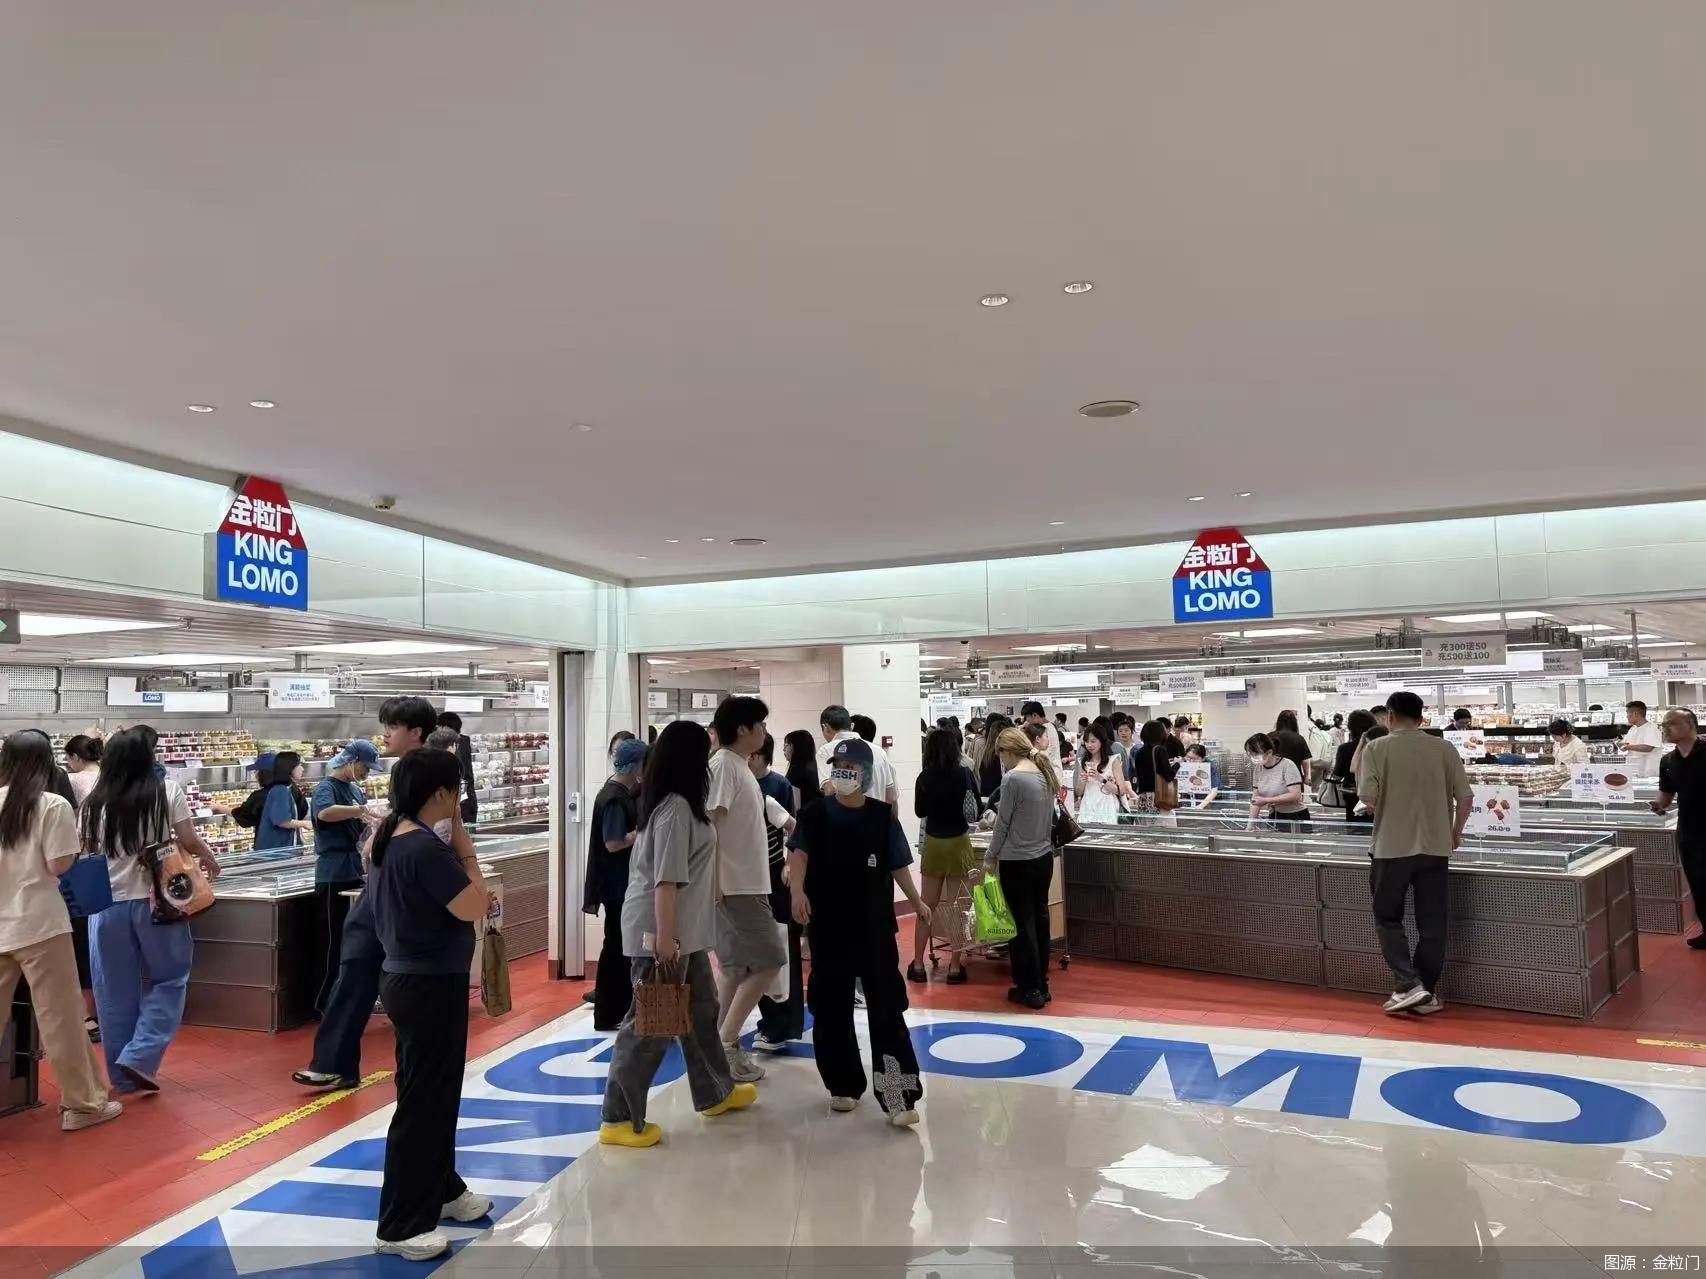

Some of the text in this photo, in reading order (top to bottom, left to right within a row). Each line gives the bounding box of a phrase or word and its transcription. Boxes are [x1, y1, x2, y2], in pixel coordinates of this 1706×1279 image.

[228, 494, 297, 536] 金粒门
[234, 530, 293, 565] KING
[1183, 542, 1256, 568] 金粒门
[228, 560, 299, 596] LOMO
[1189, 567, 1253, 590] KING
[1184, 589, 1261, 613] LOMO
[1438, 651, 1490, 661] 充500送100
[1440, 642, 1487, 651] 充300送50
